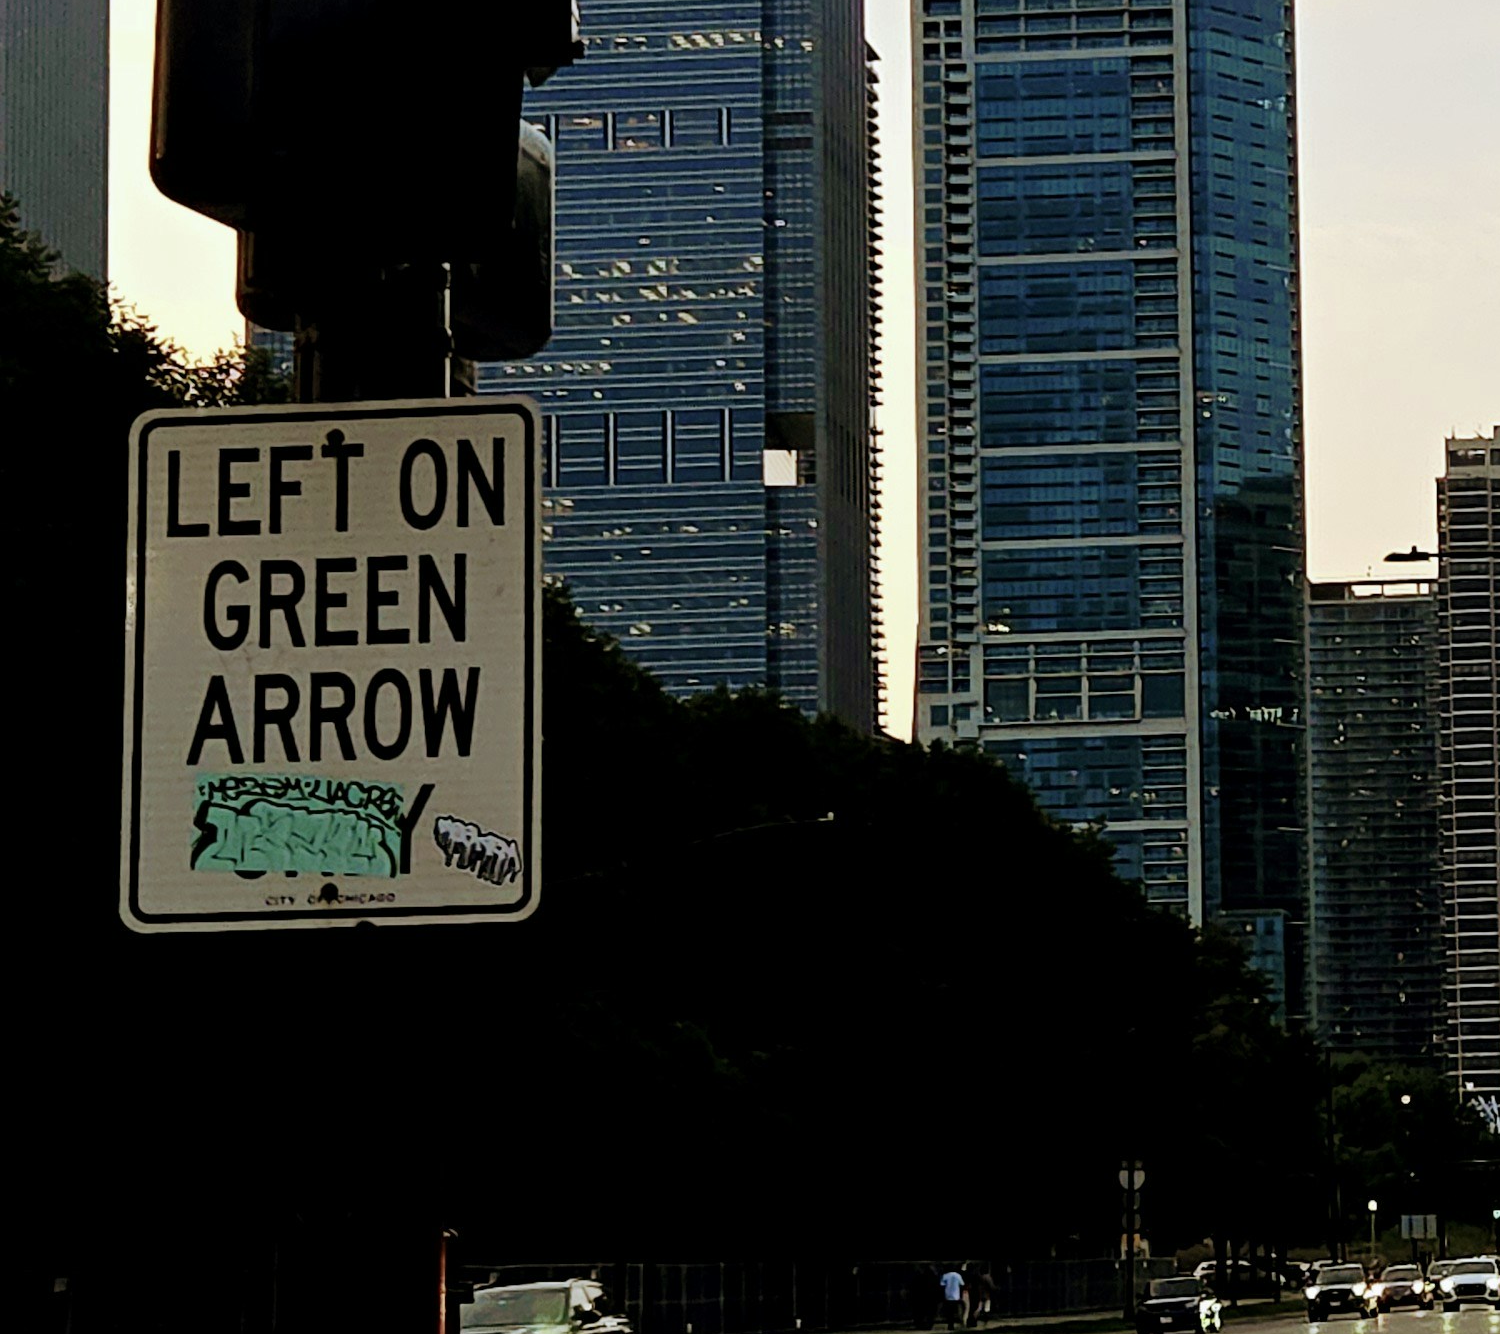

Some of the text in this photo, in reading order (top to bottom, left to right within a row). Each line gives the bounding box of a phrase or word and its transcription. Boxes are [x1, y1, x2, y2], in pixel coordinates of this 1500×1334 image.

[166, 437, 506, 538] LEFT ON
[203, 553, 467, 651] GREEN
[187, 667, 481, 765] ARROW
[265, 895, 295, 906] CITY
[338, 892, 396, 905] CHICAGO
